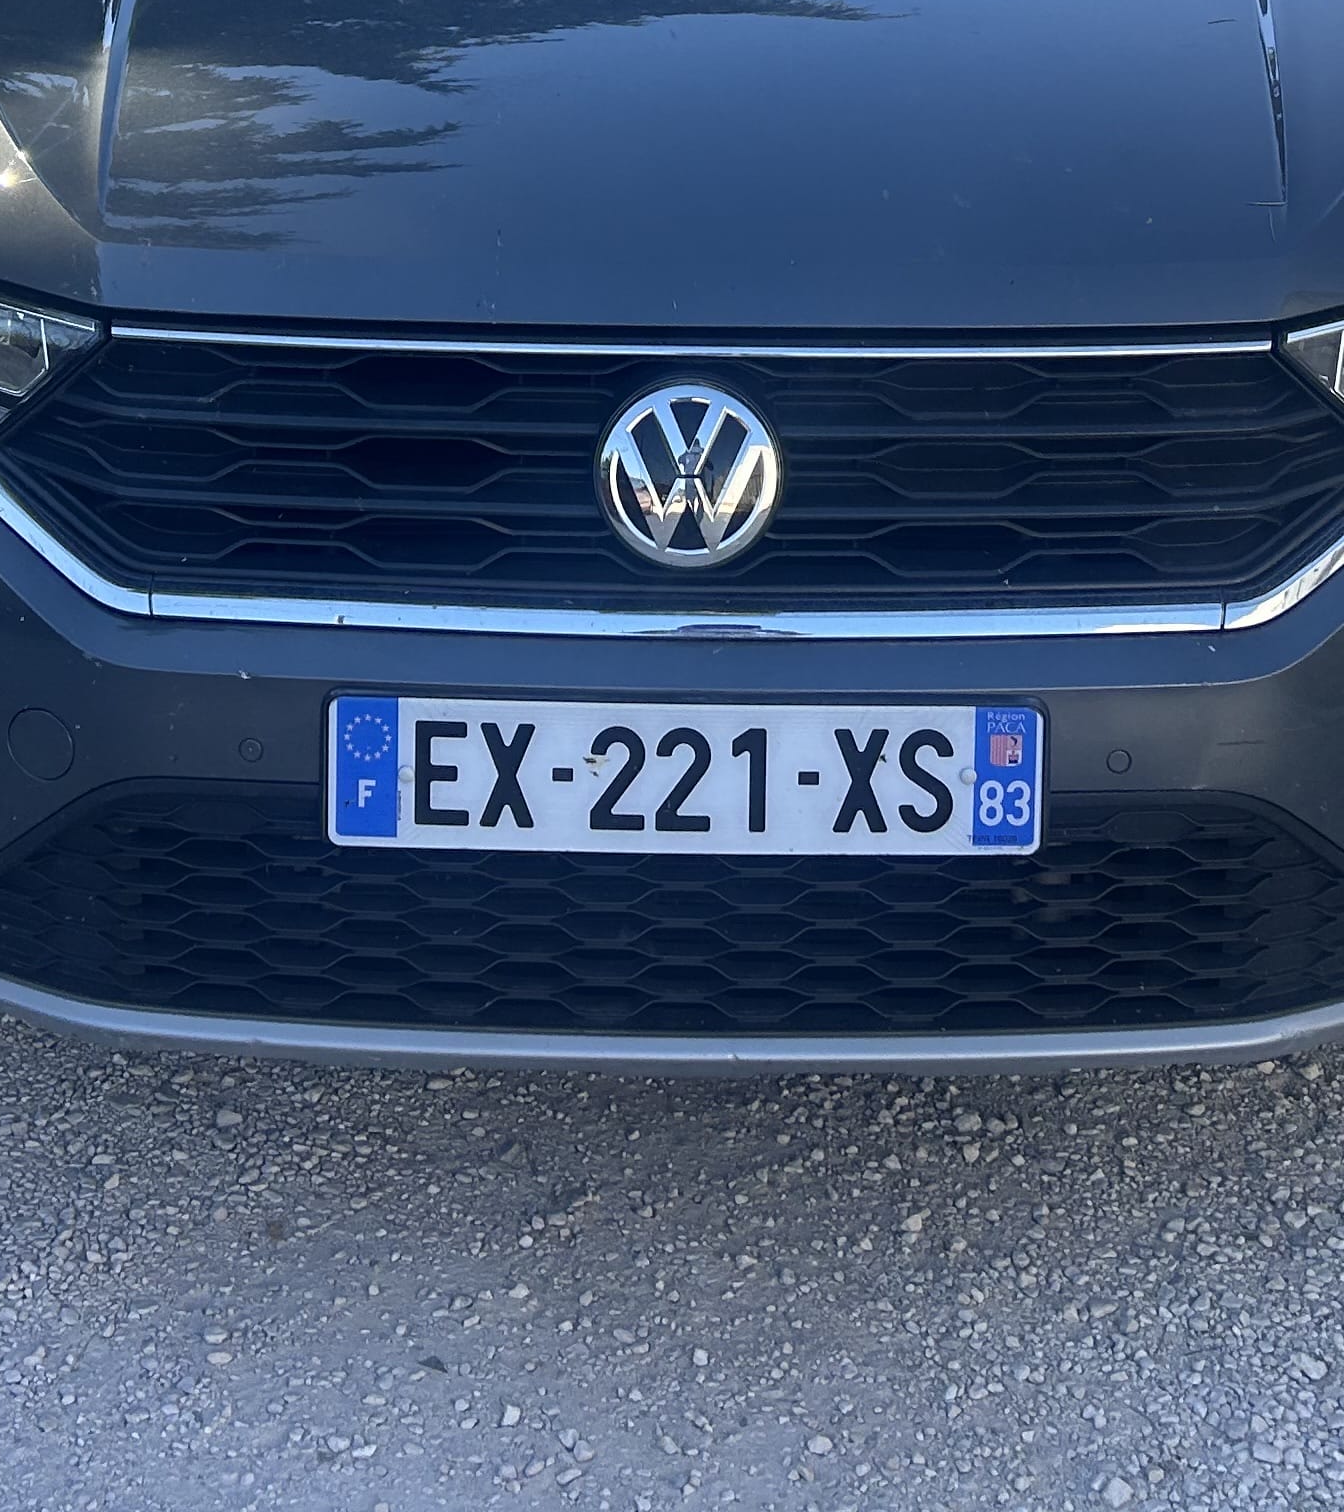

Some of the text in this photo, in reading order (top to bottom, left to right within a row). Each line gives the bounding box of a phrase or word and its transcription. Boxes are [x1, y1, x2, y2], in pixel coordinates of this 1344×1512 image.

[986, 722, 1027, 734] PACA
[987, 711, 1026, 723] Région
[413, 719, 955, 834] EX-221-XS
[358, 779, 377, 809] F
[979, 779, 1031, 827] 83
